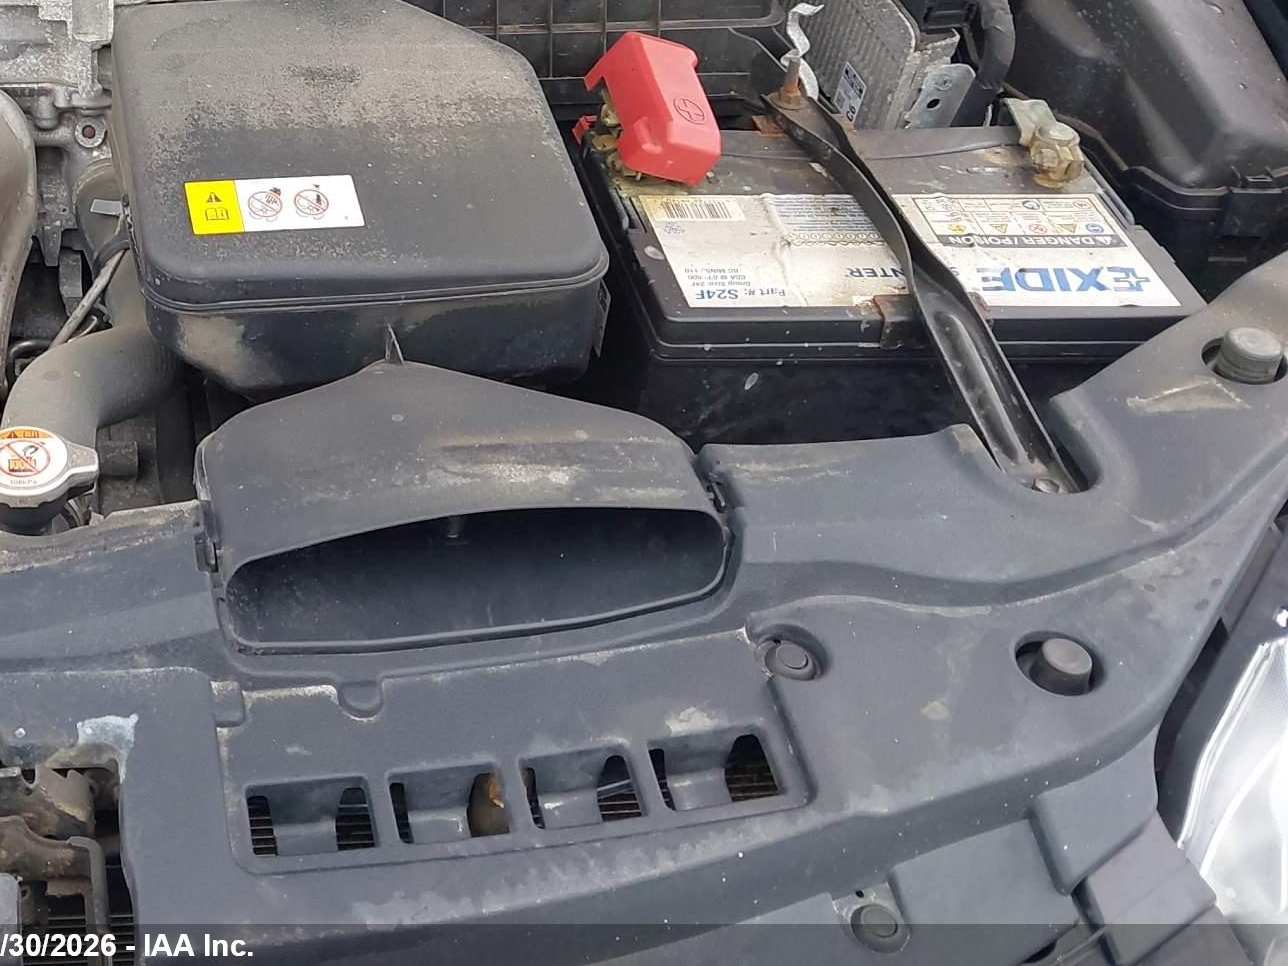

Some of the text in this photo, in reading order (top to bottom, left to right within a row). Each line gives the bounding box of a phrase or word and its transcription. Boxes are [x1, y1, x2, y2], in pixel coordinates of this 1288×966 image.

[1021, 235, 1096, 246] DANGER
[976, 266, 1151, 292] EXIDE
[695, 289, 739, 300] S24F
[759, 287, 786, 297] Part
